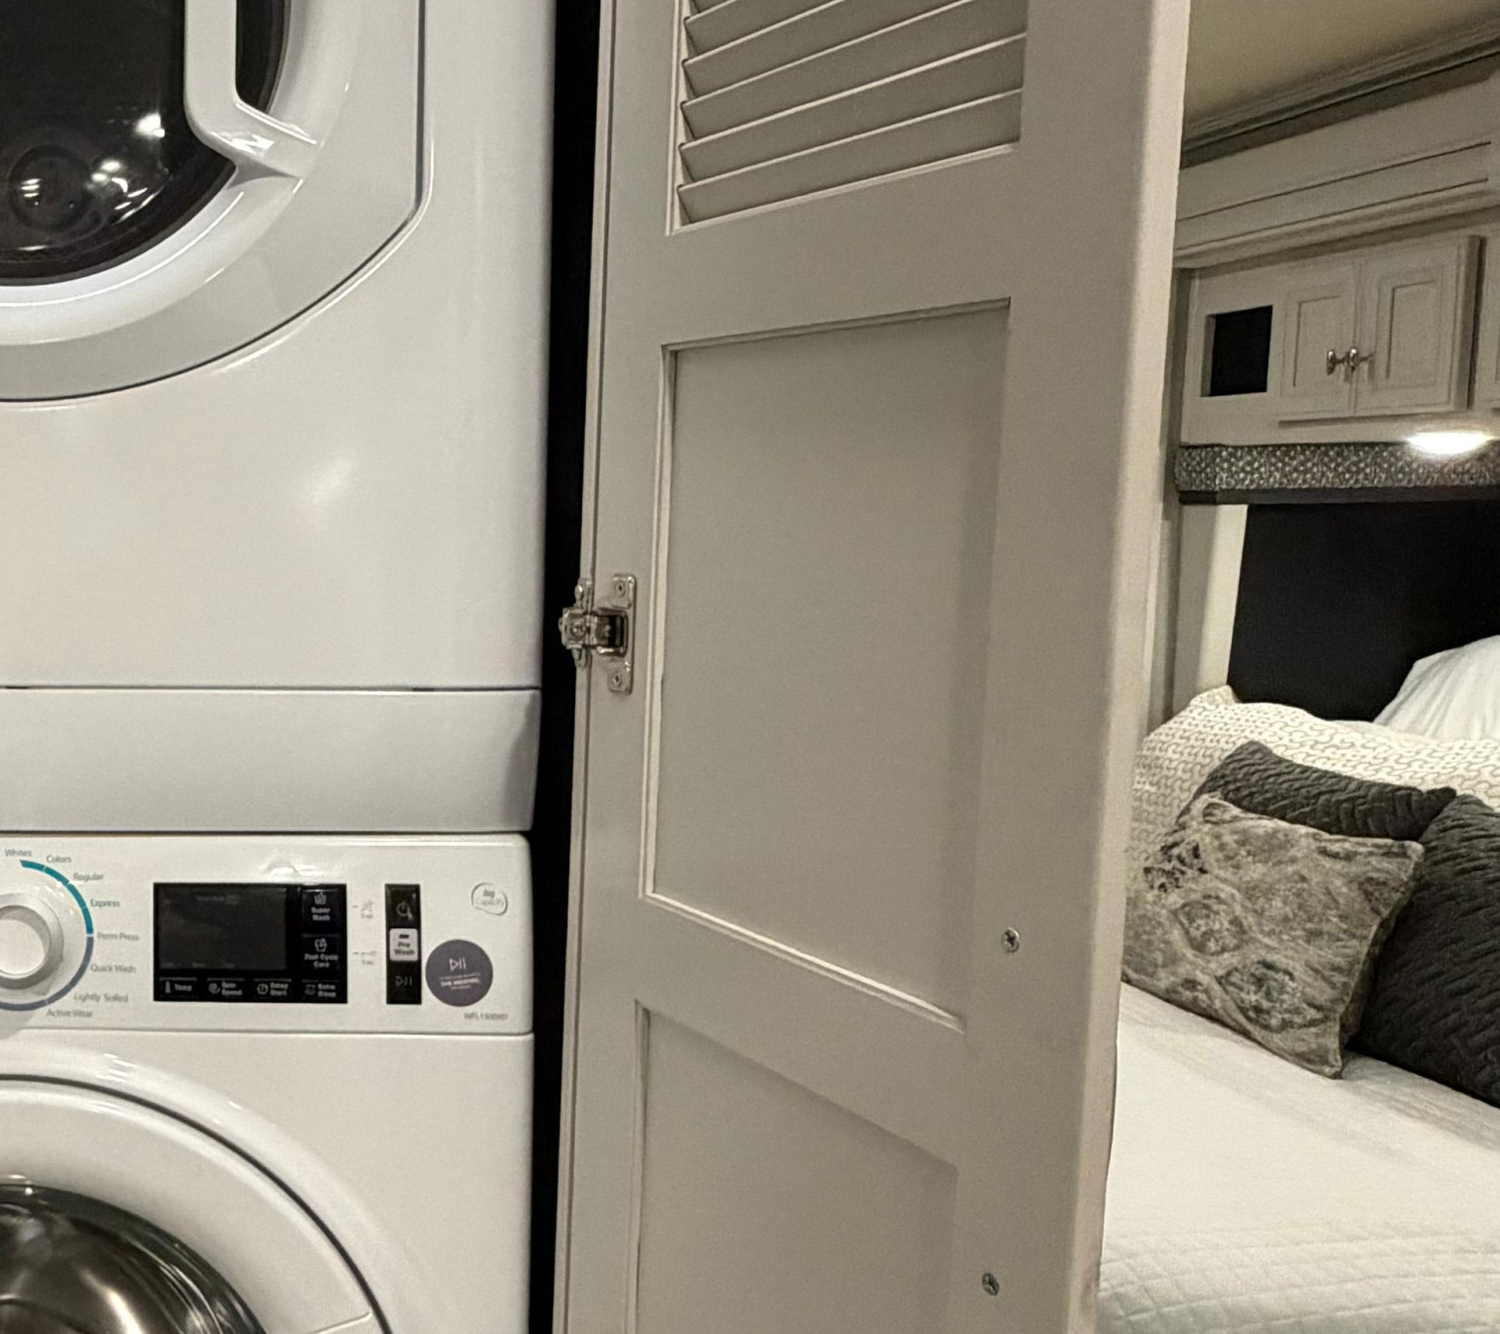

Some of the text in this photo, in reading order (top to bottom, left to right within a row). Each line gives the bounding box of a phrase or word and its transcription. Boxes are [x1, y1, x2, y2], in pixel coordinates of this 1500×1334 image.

[5, 849, 32, 857] Whites
[46, 854, 72, 863] Colors
[73, 872, 104, 882] Regular
[90, 898, 120, 908] Express
